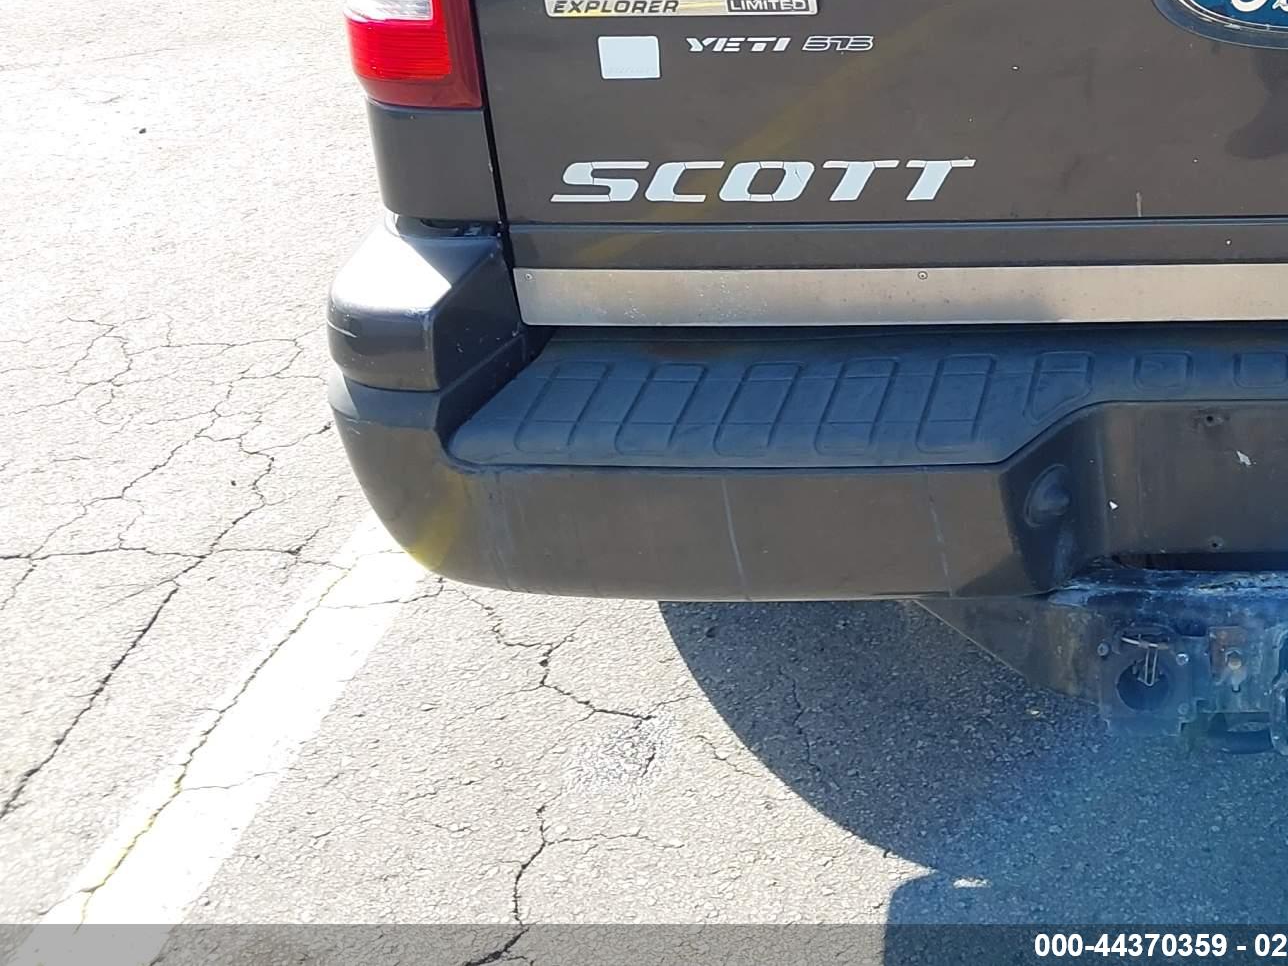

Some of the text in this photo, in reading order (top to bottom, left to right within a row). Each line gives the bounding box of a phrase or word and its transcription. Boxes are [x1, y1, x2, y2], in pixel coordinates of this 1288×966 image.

[553, 0, 680, 14] EXPLORER
[686, 36, 792, 52] YETI
[550, 158, 977, 203] SCOTT
